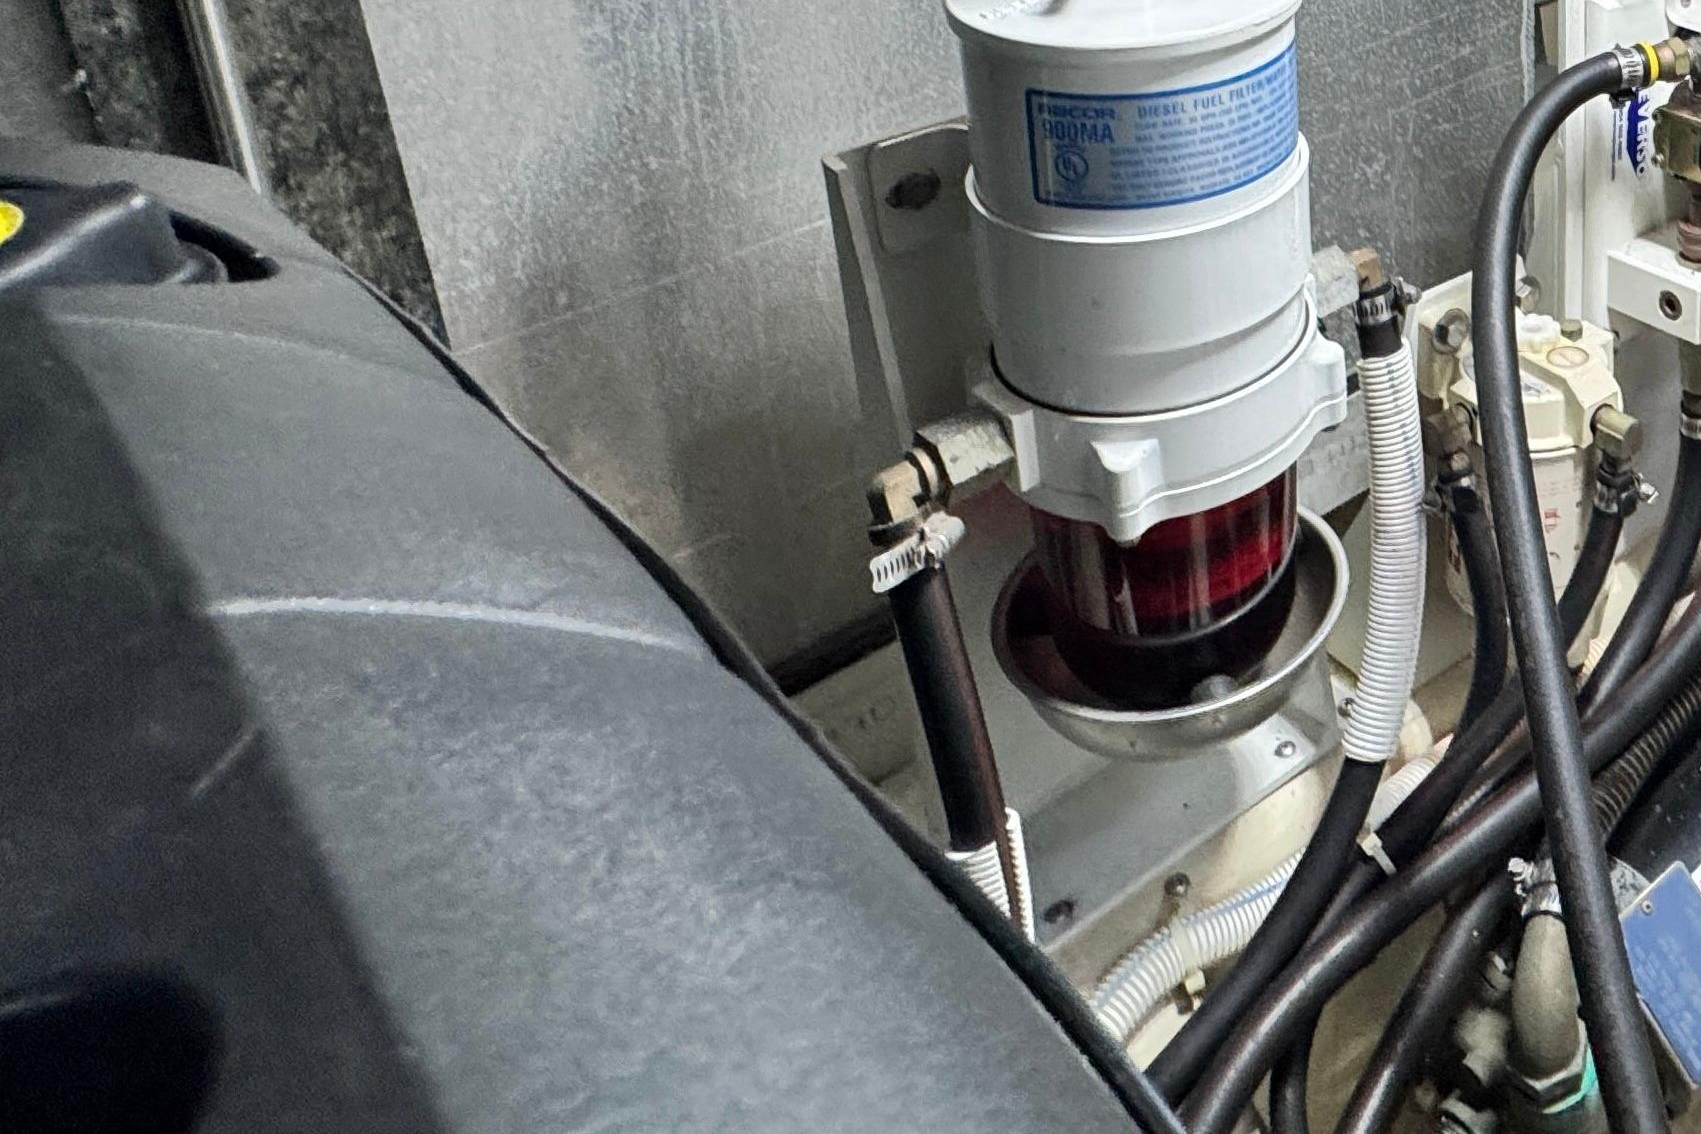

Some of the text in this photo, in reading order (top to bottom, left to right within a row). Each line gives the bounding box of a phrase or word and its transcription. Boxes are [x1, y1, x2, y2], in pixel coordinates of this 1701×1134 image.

[1136, 102, 1187, 119] DIESEL
[1193, 93, 1224, 111] FUEL
[1636, 85, 1650, 180] EVERSO
